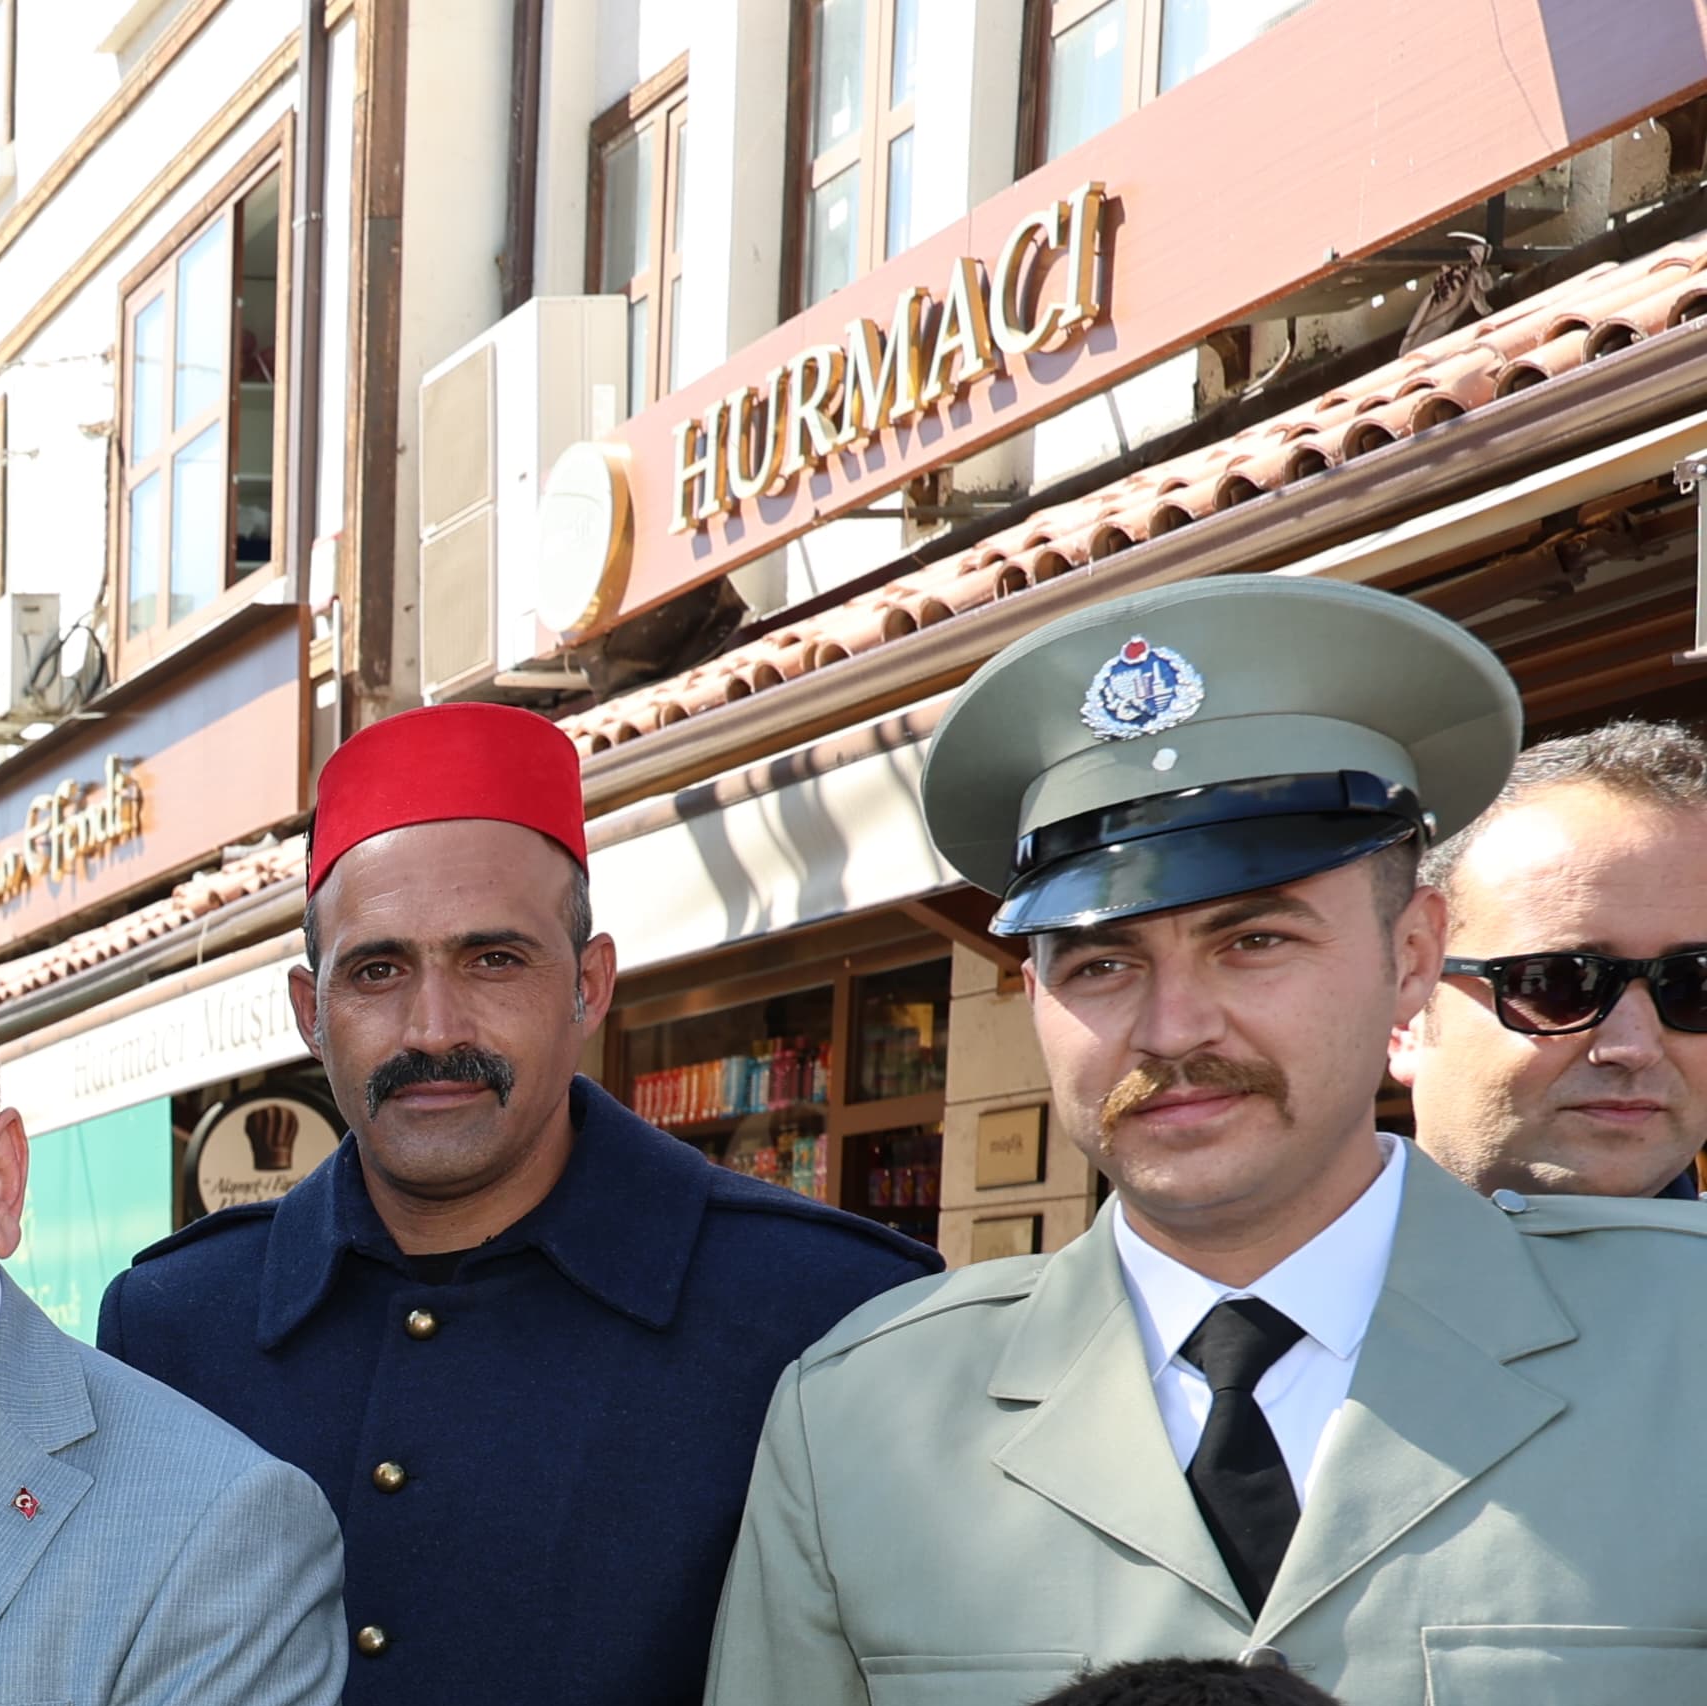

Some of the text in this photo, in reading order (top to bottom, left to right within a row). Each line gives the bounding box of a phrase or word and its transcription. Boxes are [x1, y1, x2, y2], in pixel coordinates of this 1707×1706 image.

[667, 181, 1105, 535] HURMACI
[24, 753, 133, 882] Efendi
[73, 1021, 186, 1099] Hurmacı
